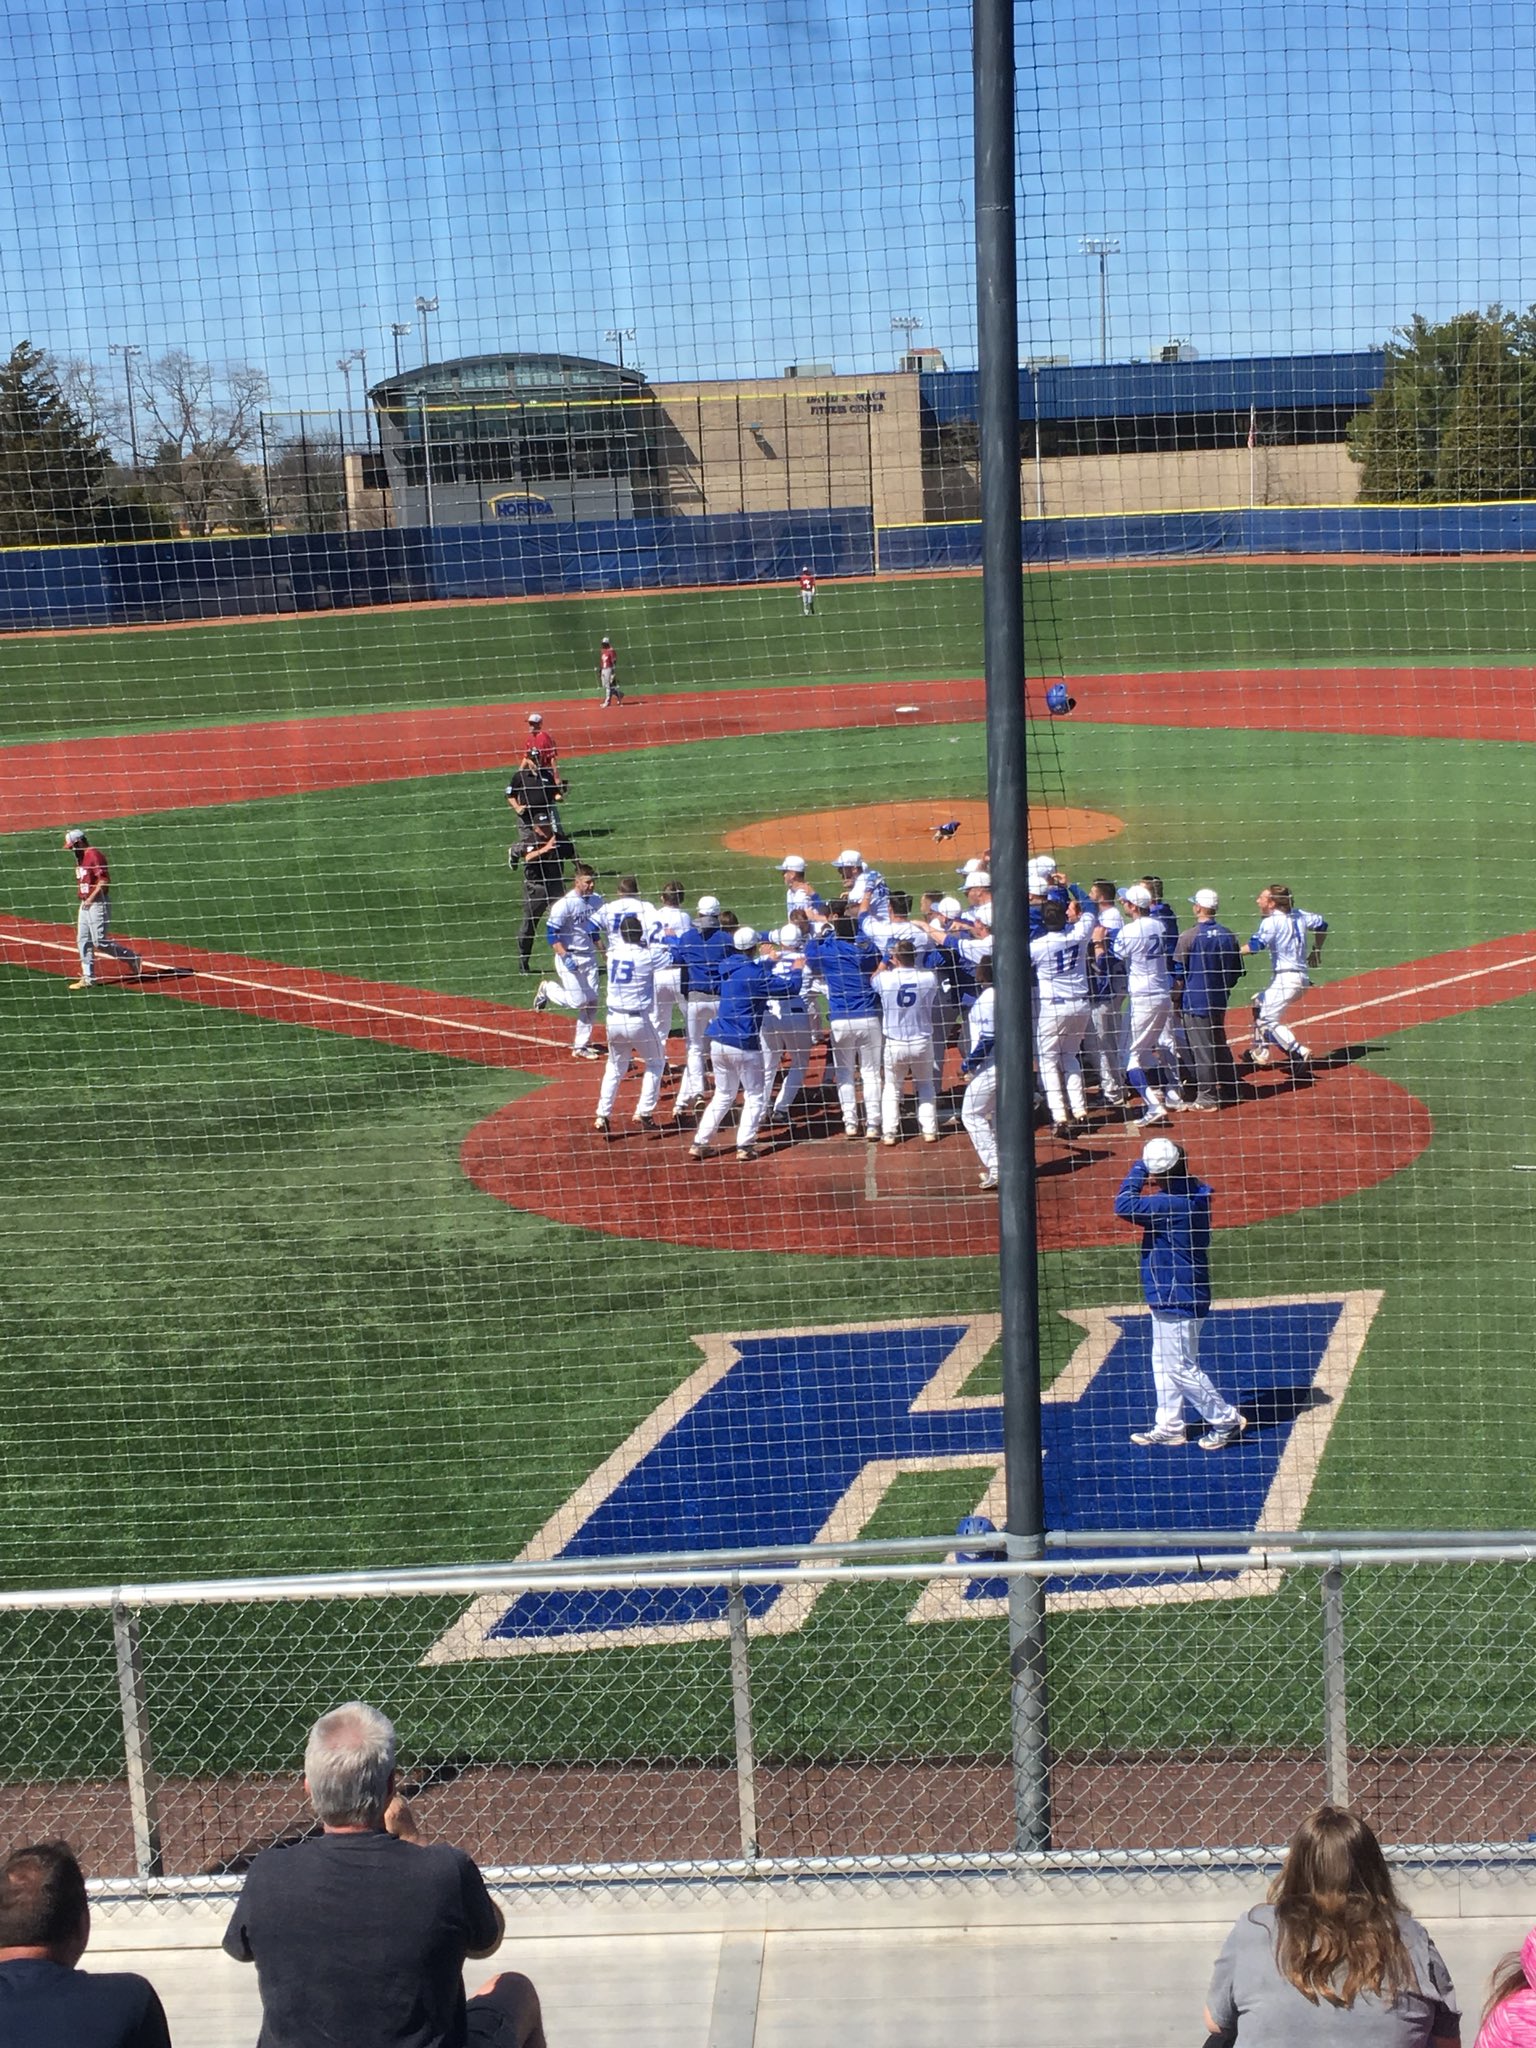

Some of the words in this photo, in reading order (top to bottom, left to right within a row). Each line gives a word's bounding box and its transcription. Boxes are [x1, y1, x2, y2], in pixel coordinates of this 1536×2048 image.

[611, 959, 635, 984] 13
[1054, 944, 1080, 974] 17
[896, 983, 918, 1008] 6
